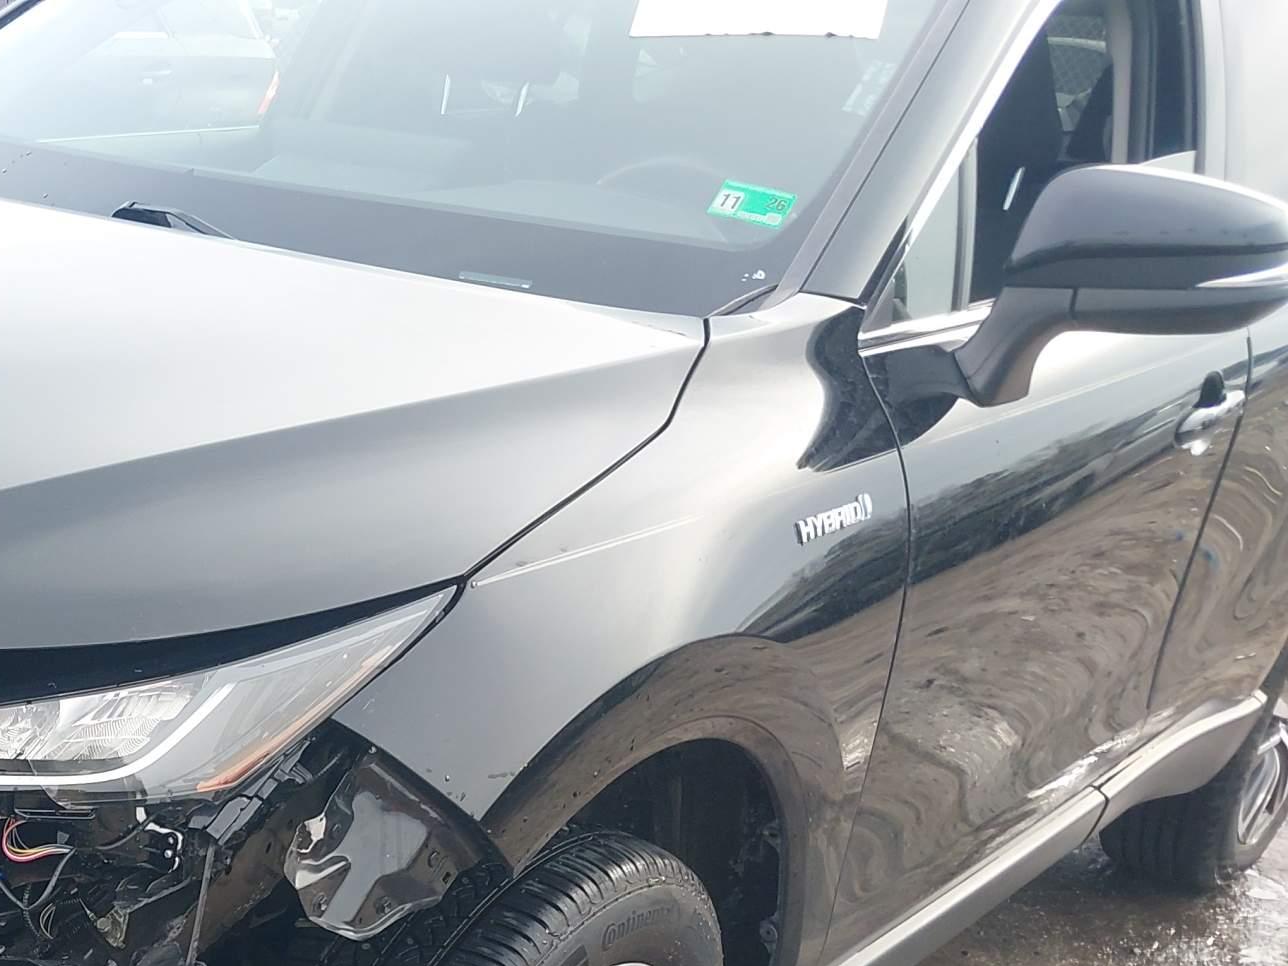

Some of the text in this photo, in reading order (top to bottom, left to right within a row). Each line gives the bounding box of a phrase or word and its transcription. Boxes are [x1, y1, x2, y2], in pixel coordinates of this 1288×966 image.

[720, 193, 787, 212] 11 26
[796, 501, 862, 545] HYBRID
